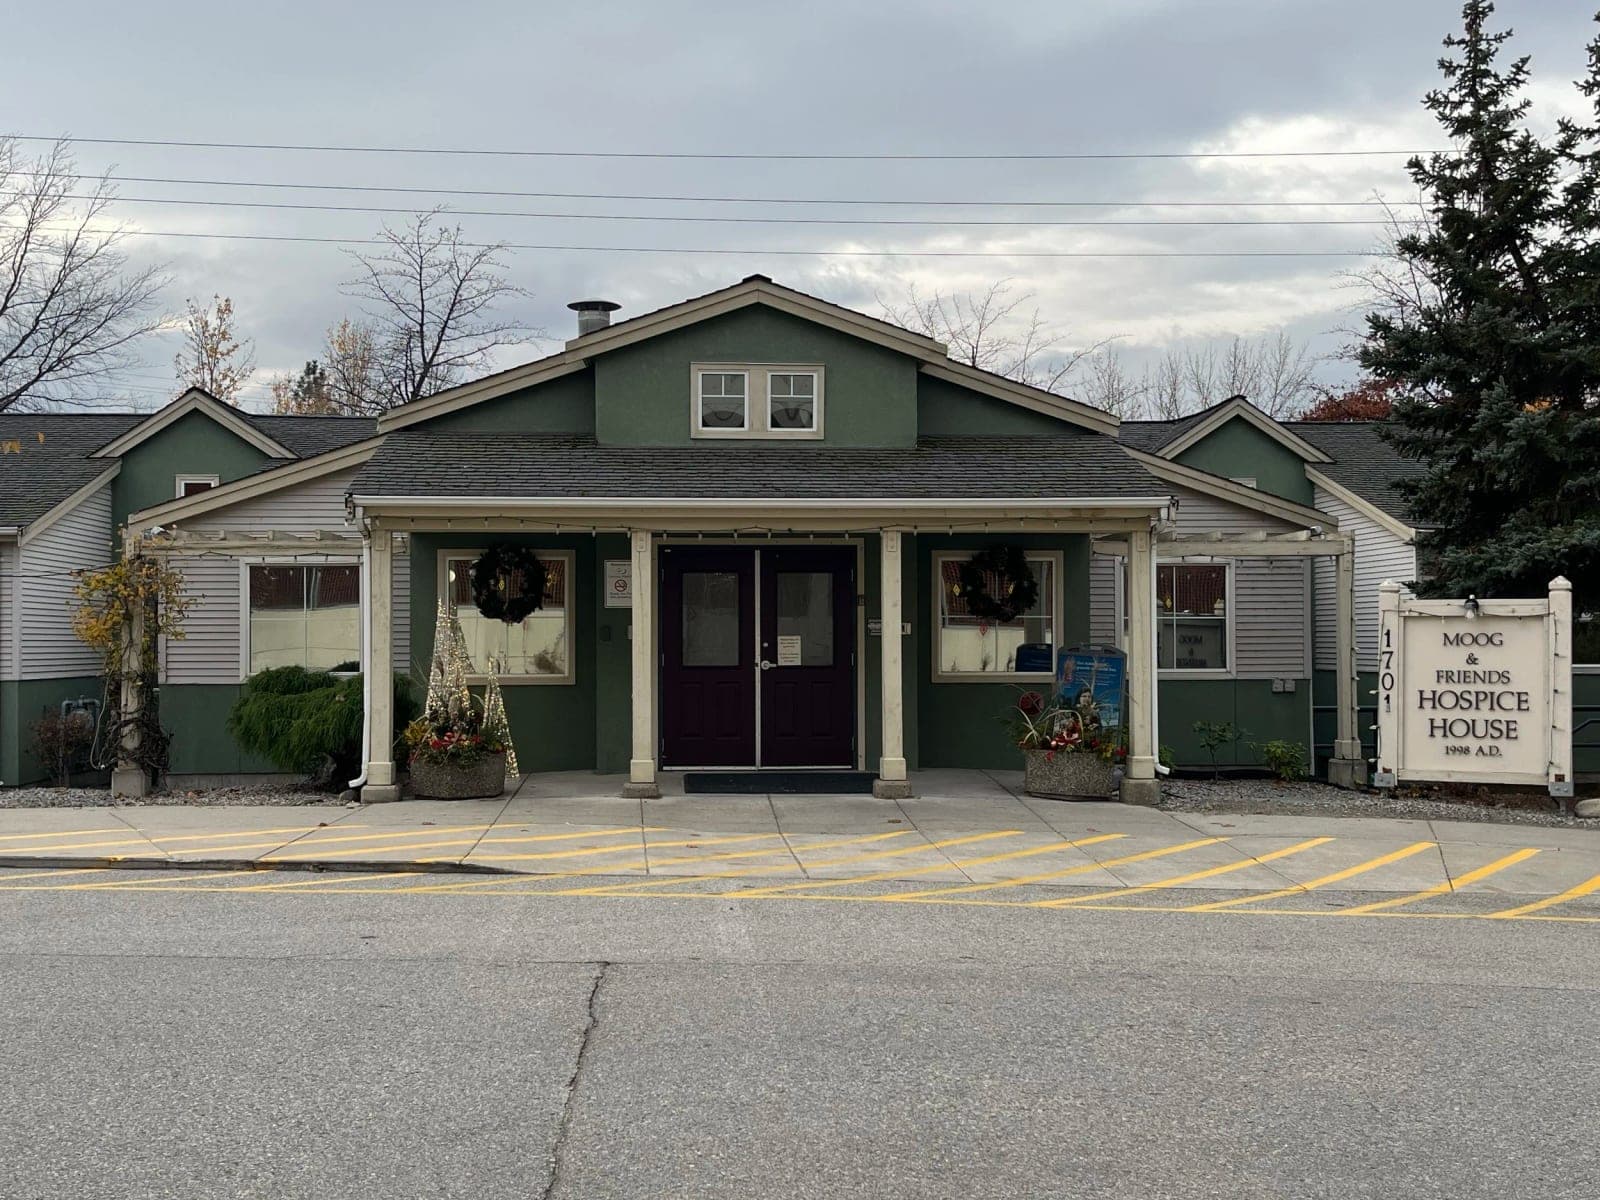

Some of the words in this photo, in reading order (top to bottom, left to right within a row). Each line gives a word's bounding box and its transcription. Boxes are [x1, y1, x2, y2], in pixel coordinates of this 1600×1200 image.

[1442, 632, 1504, 647] MOOG
[1465, 652, 1480, 666] &
[1435, 669, 1511, 685] FRIENDS
[1417, 689, 1530, 712] HOSPICE
[1427, 717, 1519, 741] HOUSE
[1444, 745, 1471, 756] 1998
[1474, 745, 1503, 757] A.D.
